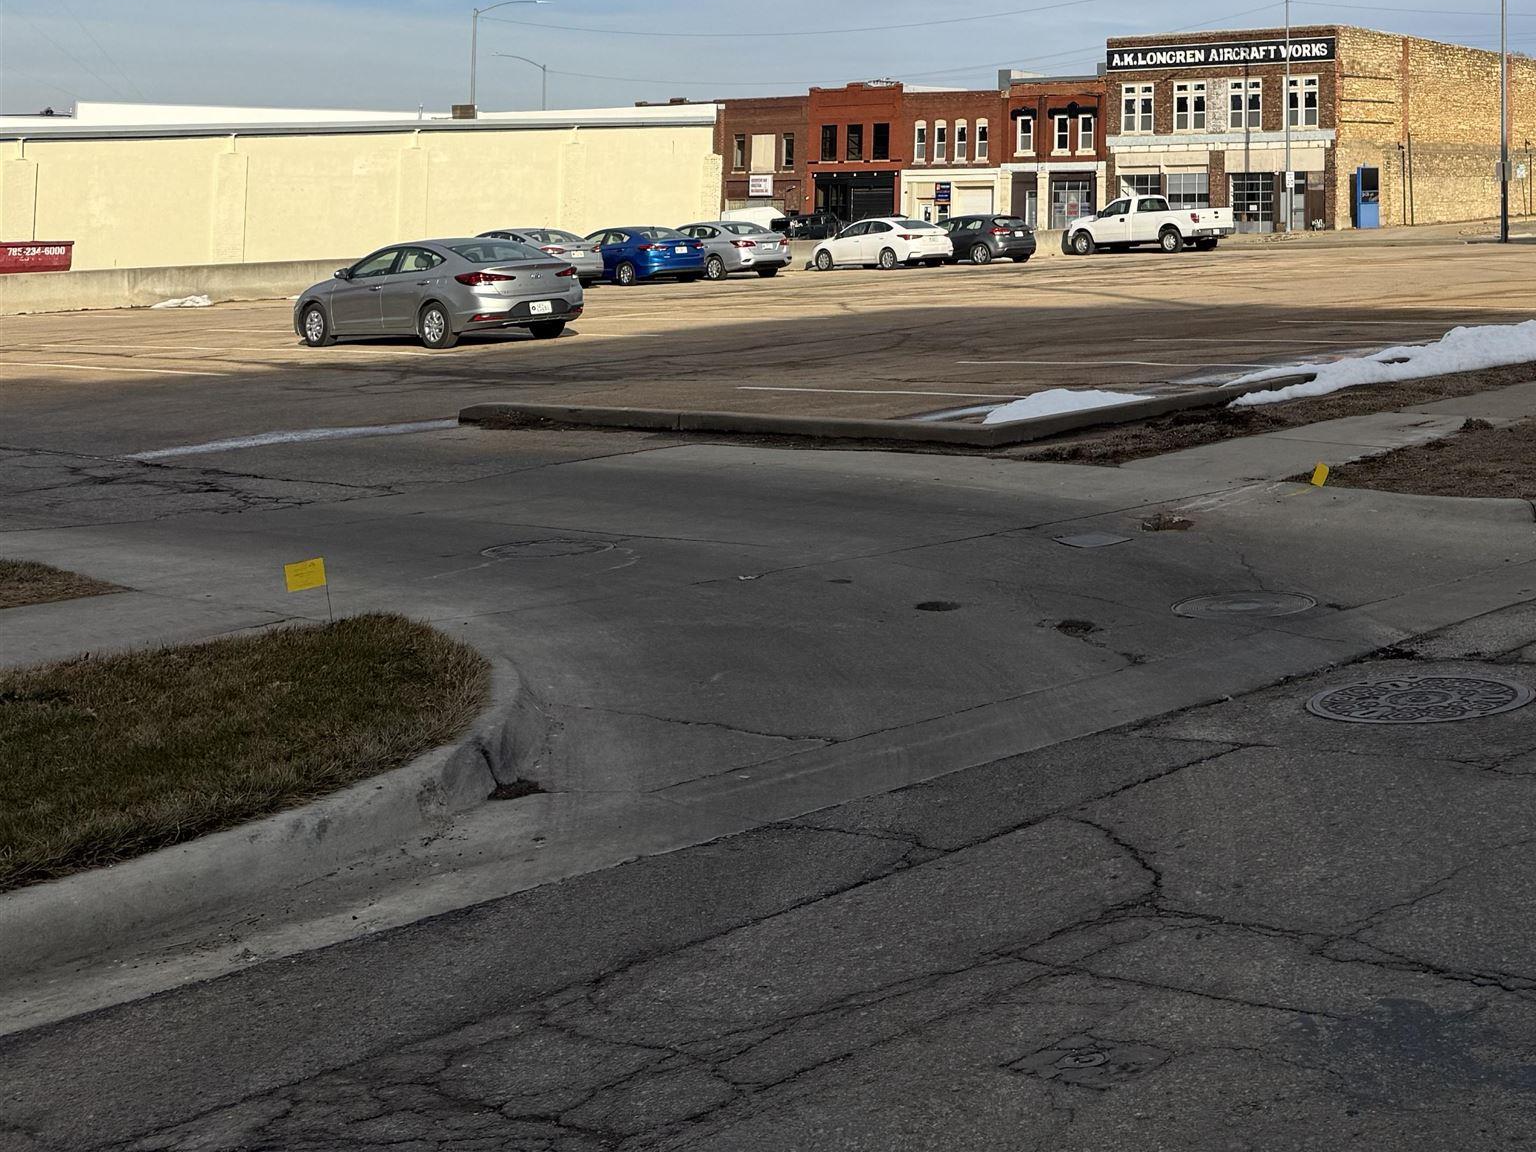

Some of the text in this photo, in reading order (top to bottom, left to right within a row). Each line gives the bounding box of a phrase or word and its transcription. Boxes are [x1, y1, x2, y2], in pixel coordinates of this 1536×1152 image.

[1209, 45, 1277, 62] AIRCRAFT
[1279, 43, 1328, 58] WORKS
[7, 246, 66, 257] 785-234-6000
